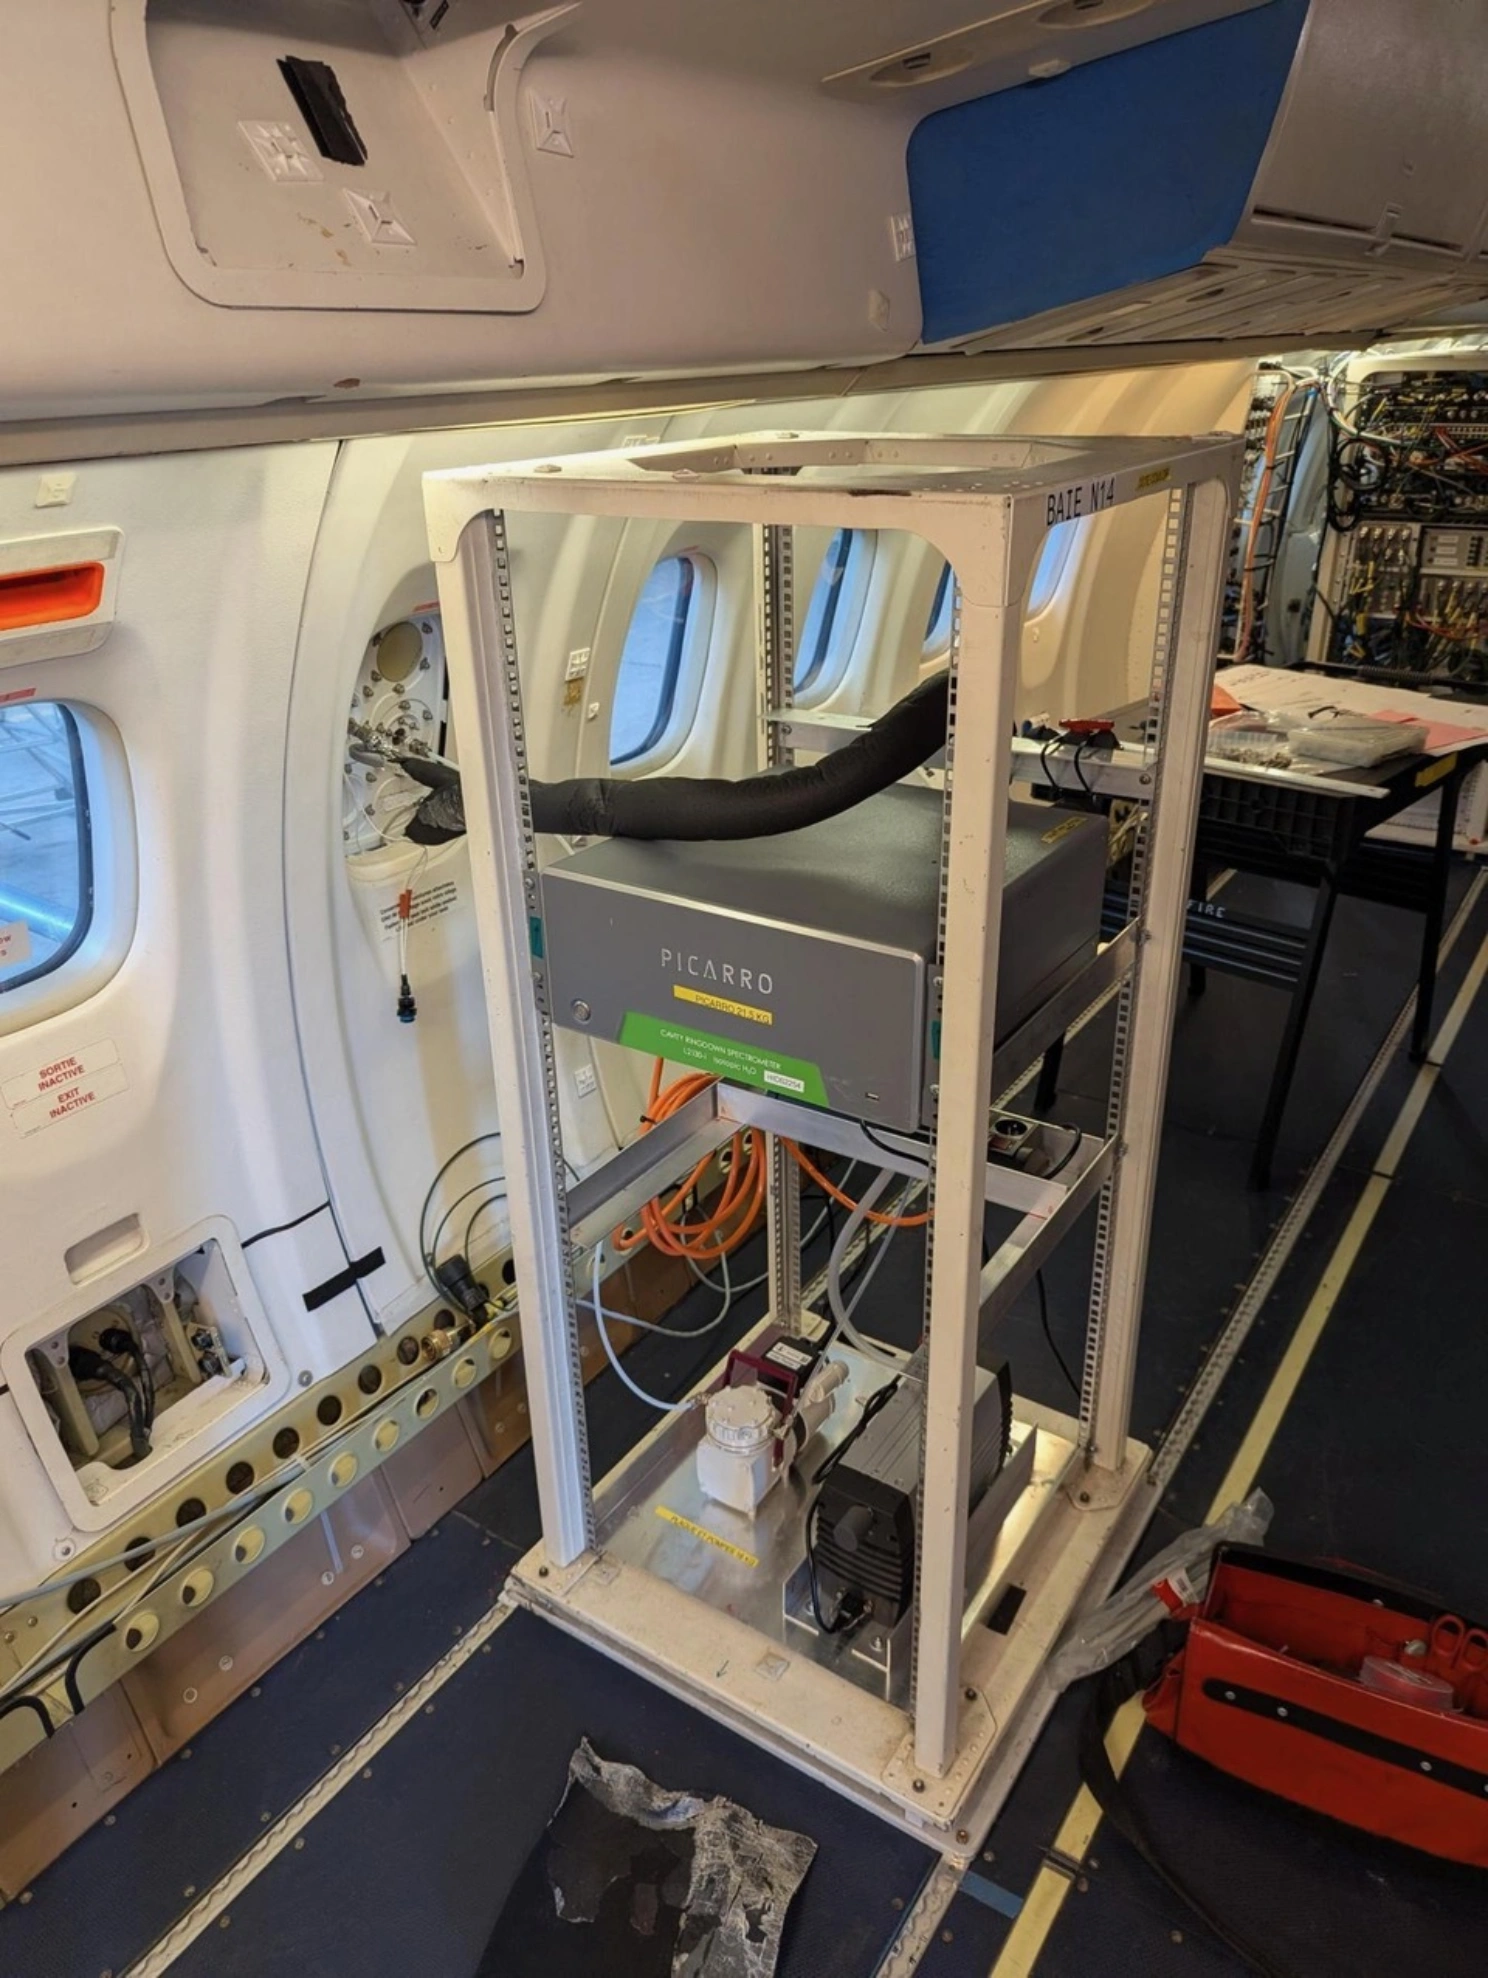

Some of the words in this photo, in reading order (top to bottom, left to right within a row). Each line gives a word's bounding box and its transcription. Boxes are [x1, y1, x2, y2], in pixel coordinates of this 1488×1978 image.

[1047, 486, 1082, 526] BAIE
[661, 947, 773, 994] PICARRO
[695, 994, 736, 1013] PICARRO
[38, 1064, 85, 1091] INACTIVE
[39, 1056, 77, 1079] SORTIE
[49, 1091, 95, 1118] INACTIVE
[57, 1086, 80, 1103] EXIT
